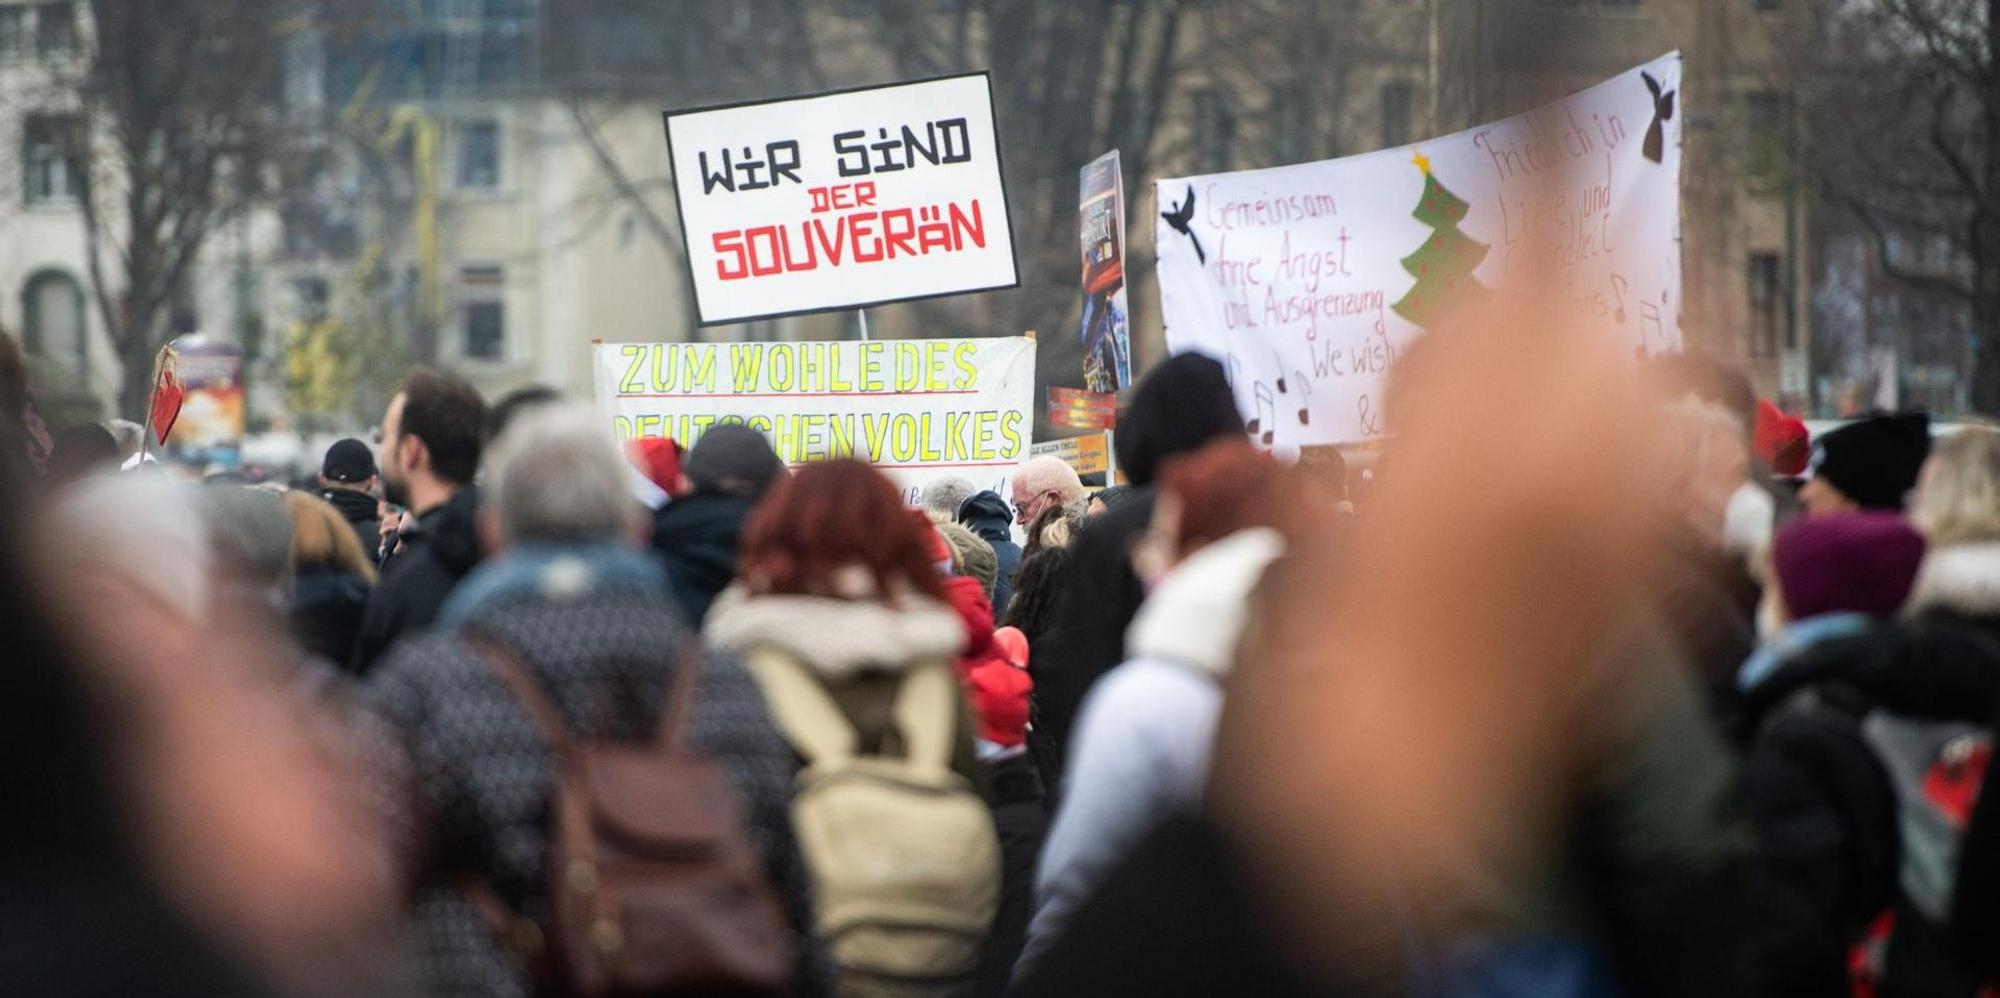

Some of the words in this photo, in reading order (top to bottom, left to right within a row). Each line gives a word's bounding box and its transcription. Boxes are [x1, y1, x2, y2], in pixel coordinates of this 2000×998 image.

[1473, 102, 1595, 182] Friech
[1593, 112, 1627, 150] in
[807, 181, 877, 213] DER
[1205, 182, 1338, 231] Gemeinsam
[1498, 192, 1567, 246] Lie
[1583, 151, 1612, 218] und
[711, 199, 986, 281] SOUVERÄN
[1275, 226, 1352, 293] Angst
[1263, 284, 1388, 341] Ausgrenzung
[618, 344, 718, 394] ZUM
[730, 342, 885, 393] WOHLE
[894, 342, 979, 392] DES
[1310, 338, 1345, 378] We
[613, 413, 856, 464] DEUTHEN
[861, 410, 1023, 463] VOLKES
[1357, 394, 1379, 437] &
